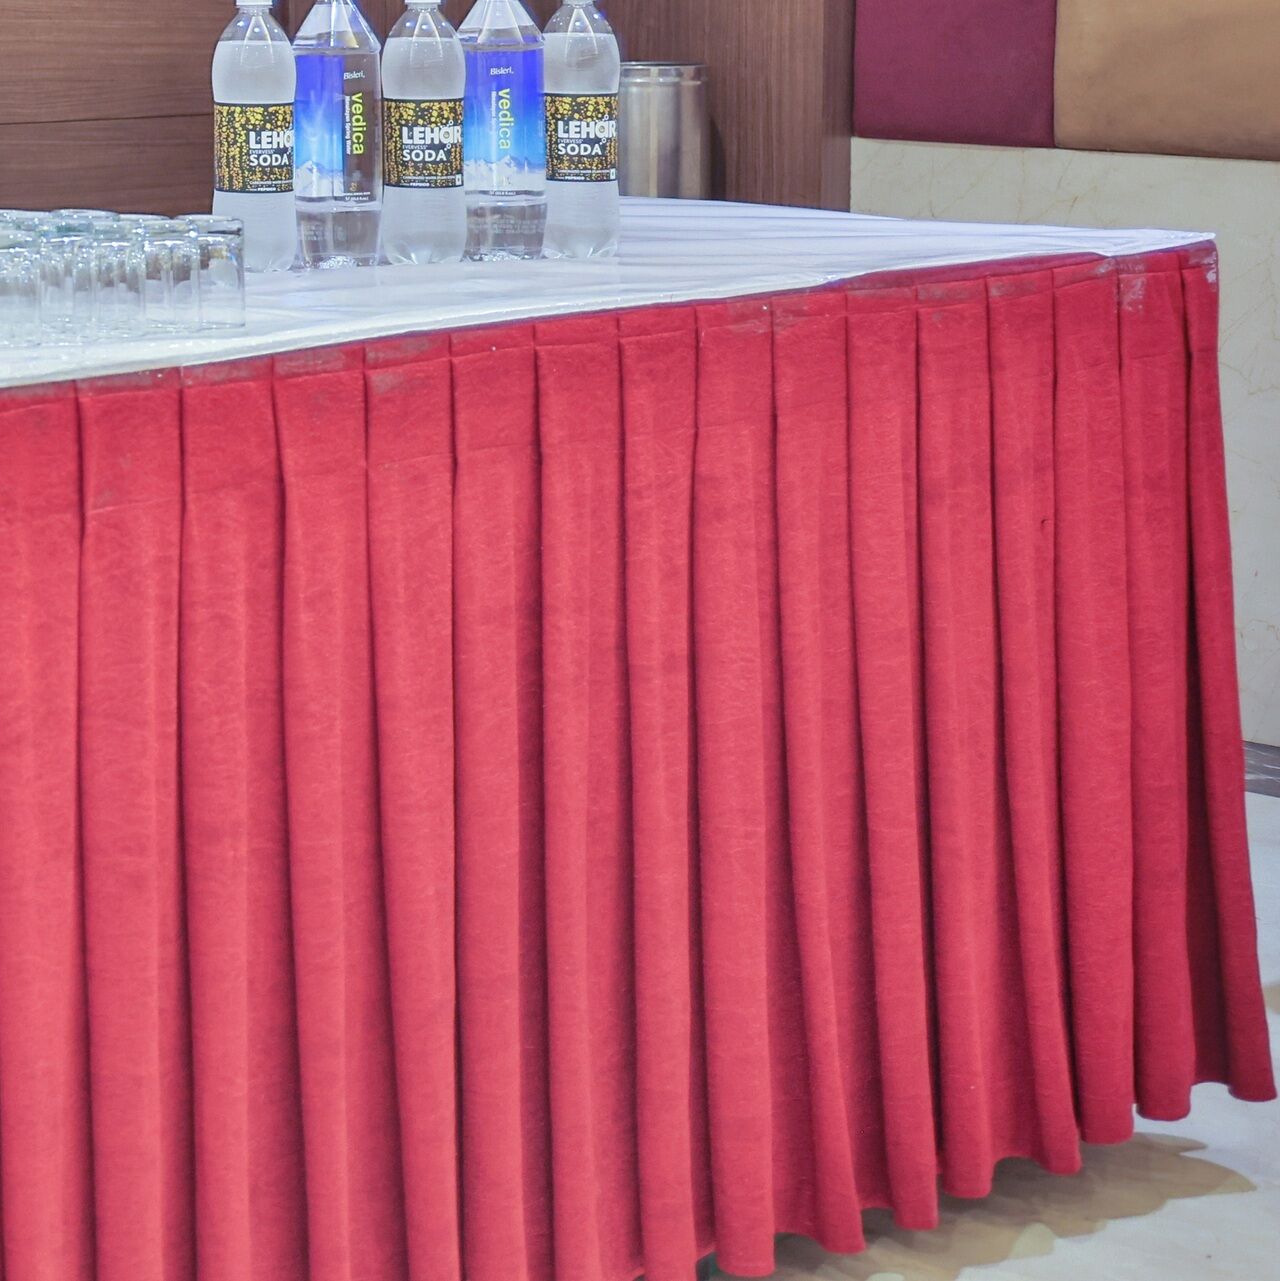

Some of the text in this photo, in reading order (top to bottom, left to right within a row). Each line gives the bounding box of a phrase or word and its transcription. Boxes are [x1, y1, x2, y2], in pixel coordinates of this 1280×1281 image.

[343, 71, 363, 80] Bisleri
[490, 66, 512, 75] Bisleri
[351, 92, 366, 155] vedica
[498, 88, 514, 149] vedica
[402, 149, 447, 162] SODA
[557, 143, 602, 156] SODA
[249, 154, 289, 166] SODA
